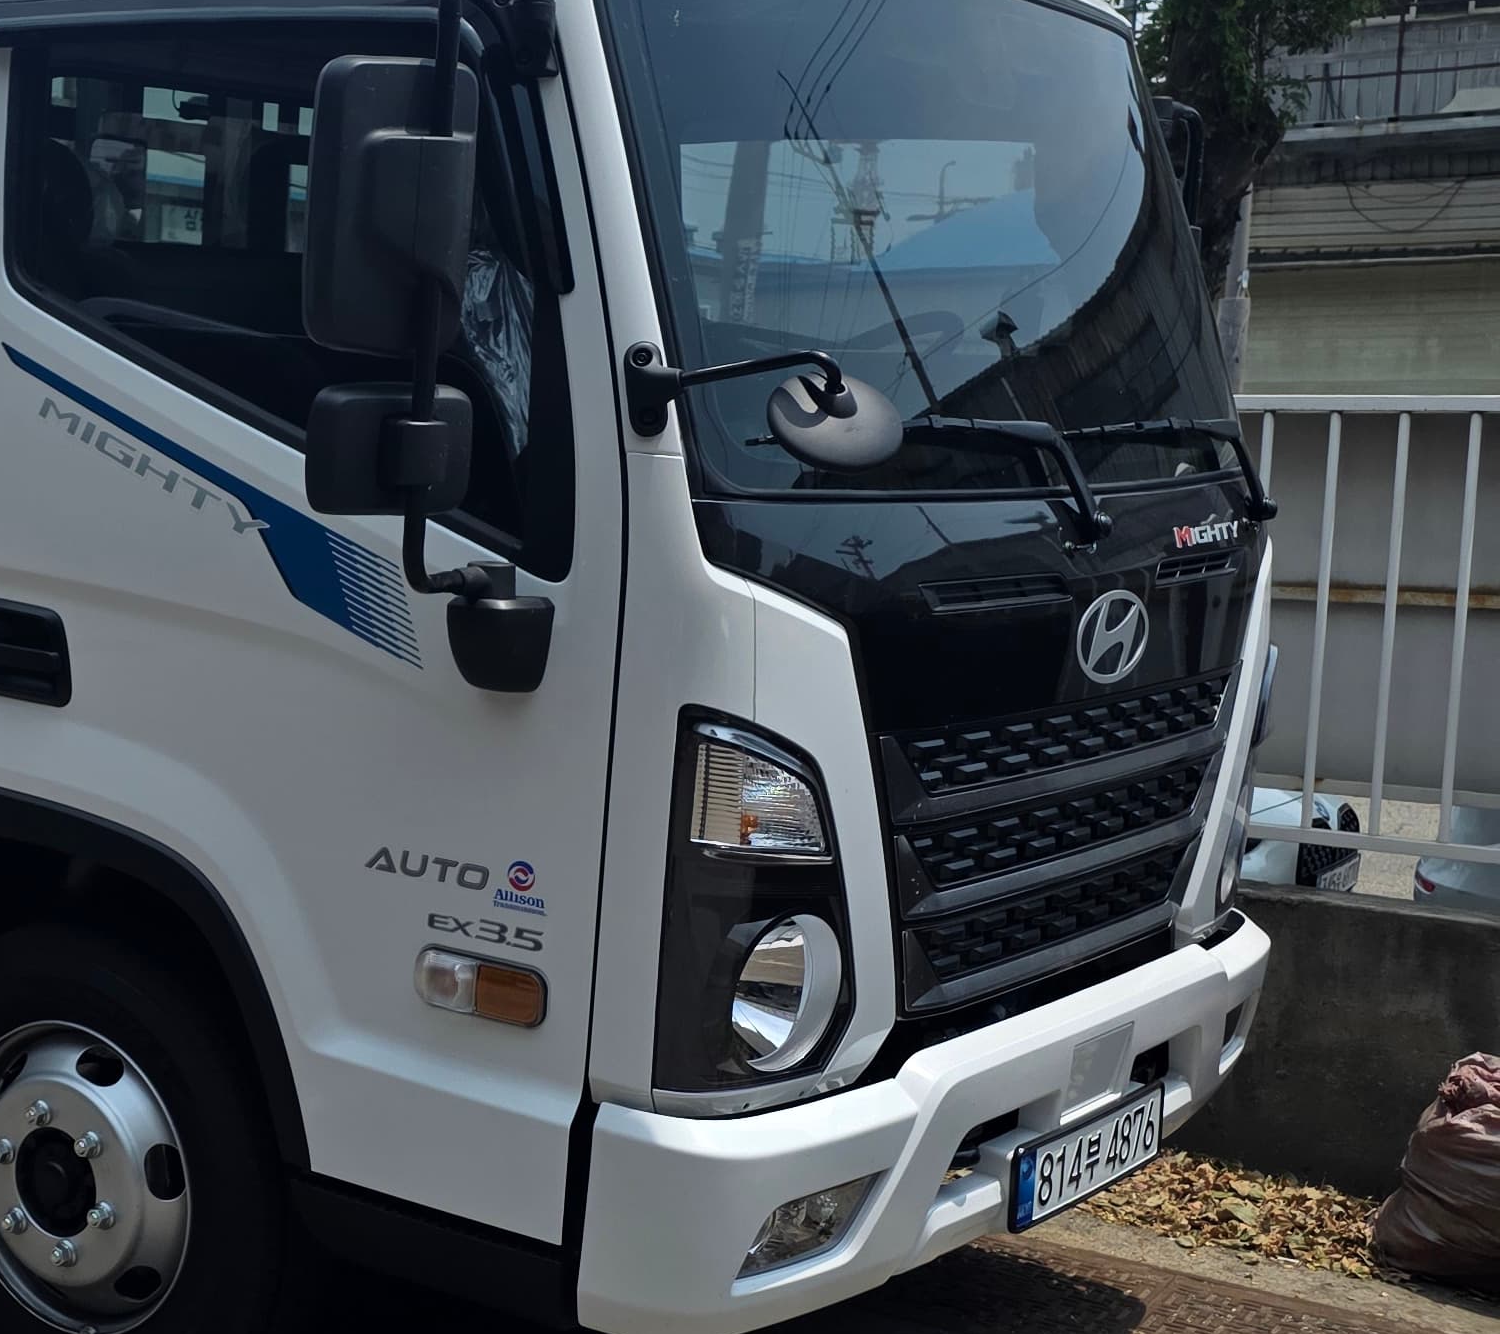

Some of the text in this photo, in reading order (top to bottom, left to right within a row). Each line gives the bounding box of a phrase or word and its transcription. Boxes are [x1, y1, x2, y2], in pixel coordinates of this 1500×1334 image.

[39, 398, 271, 535] MIGHTY
[1173, 521, 1238, 548] MIGHTY
[364, 846, 490, 891] AUTO
[493, 888, 545, 909] Allison
[427, 913, 545, 952] EX3.5
[1037, 1098, 1156, 1207] 814부 4876
